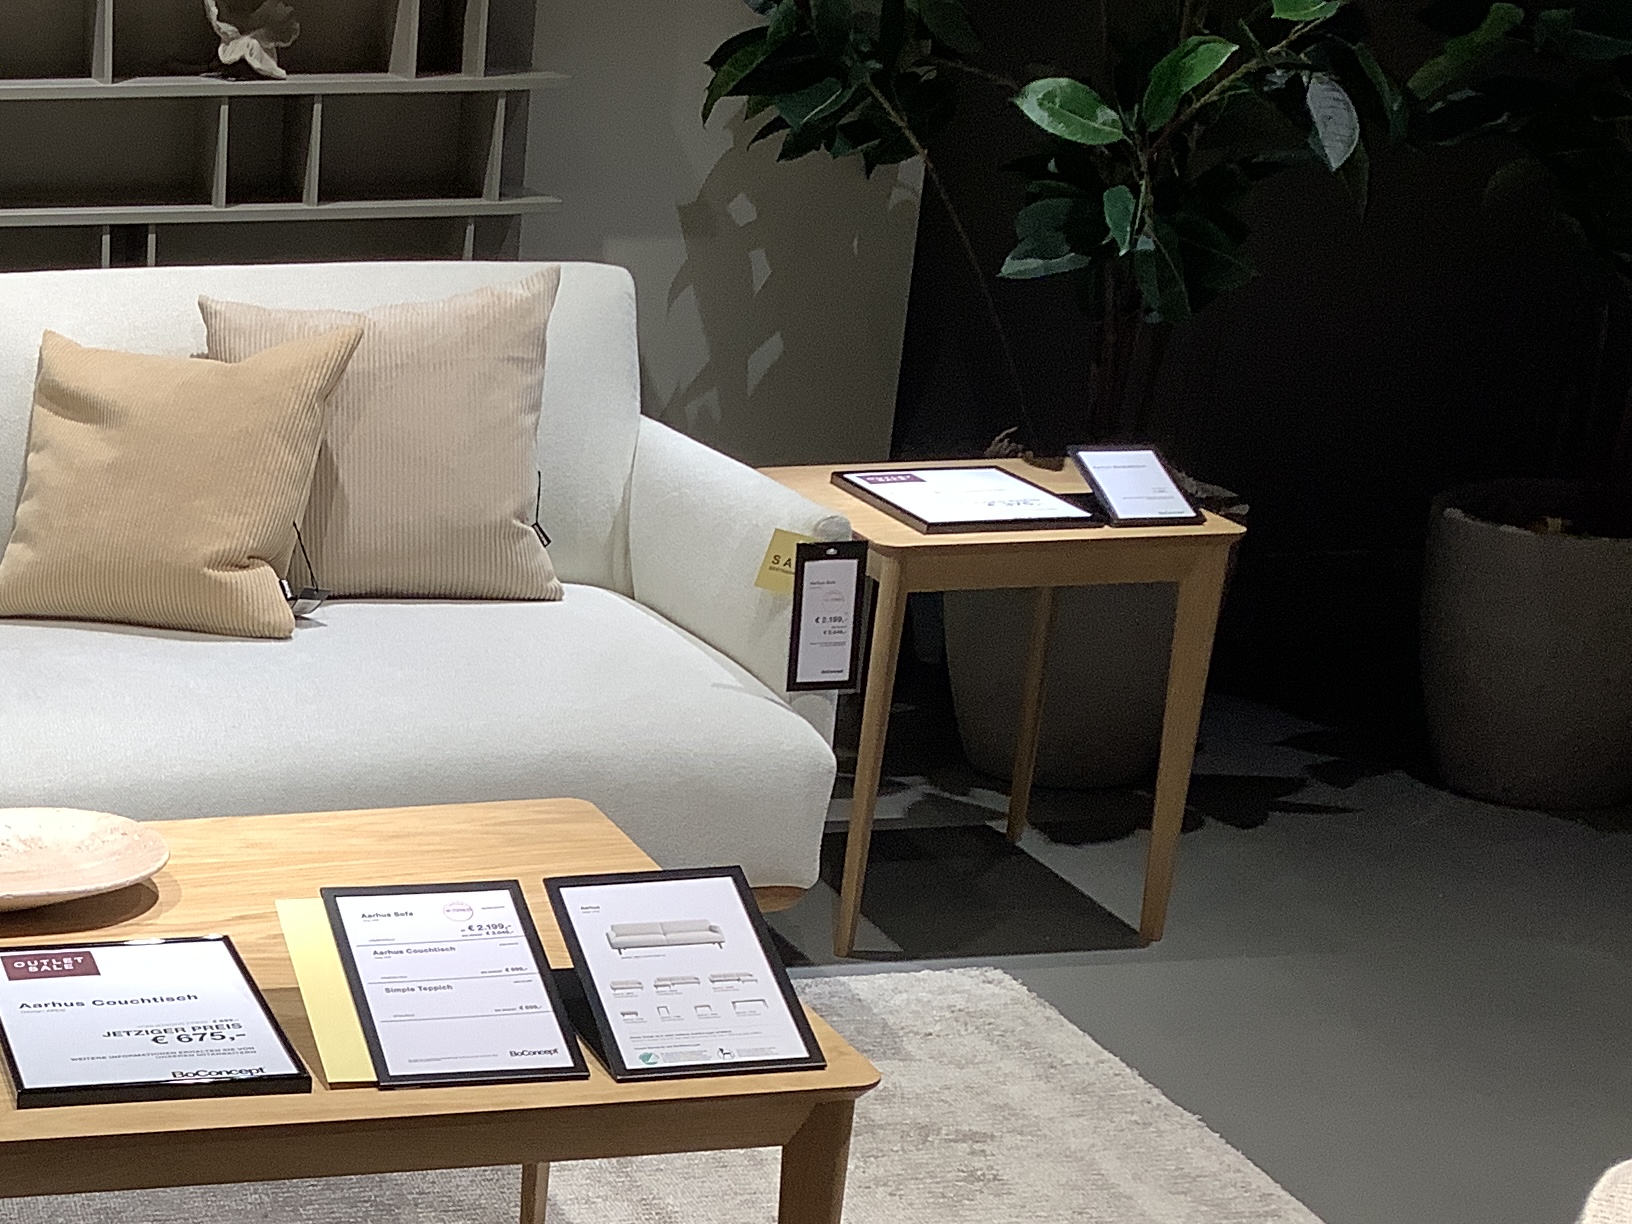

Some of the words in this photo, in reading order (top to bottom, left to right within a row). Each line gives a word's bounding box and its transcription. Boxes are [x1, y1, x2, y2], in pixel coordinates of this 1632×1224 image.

[771, 554, 792, 568] SA
[406, 946, 456, 954] Couchtisch
[13, 956, 84, 968] OUTLET
[28, 963, 74, 973] SALE
[384, 986, 415, 994] Simple
[418, 984, 453, 992] Teppich
[19, 1001, 85, 1009] Aarhus
[91, 994, 199, 1007] Couchtisch
[102, 1027, 186, 1038] JETZIGER
[191, 1022, 243, 1032] PREIS
[151, 1035, 169, 1045] €
[176, 1031, 246, 1043] 675,-
[509, 1048, 559, 1058] BoConcept
[171, 1067, 265, 1078] BoConcept
